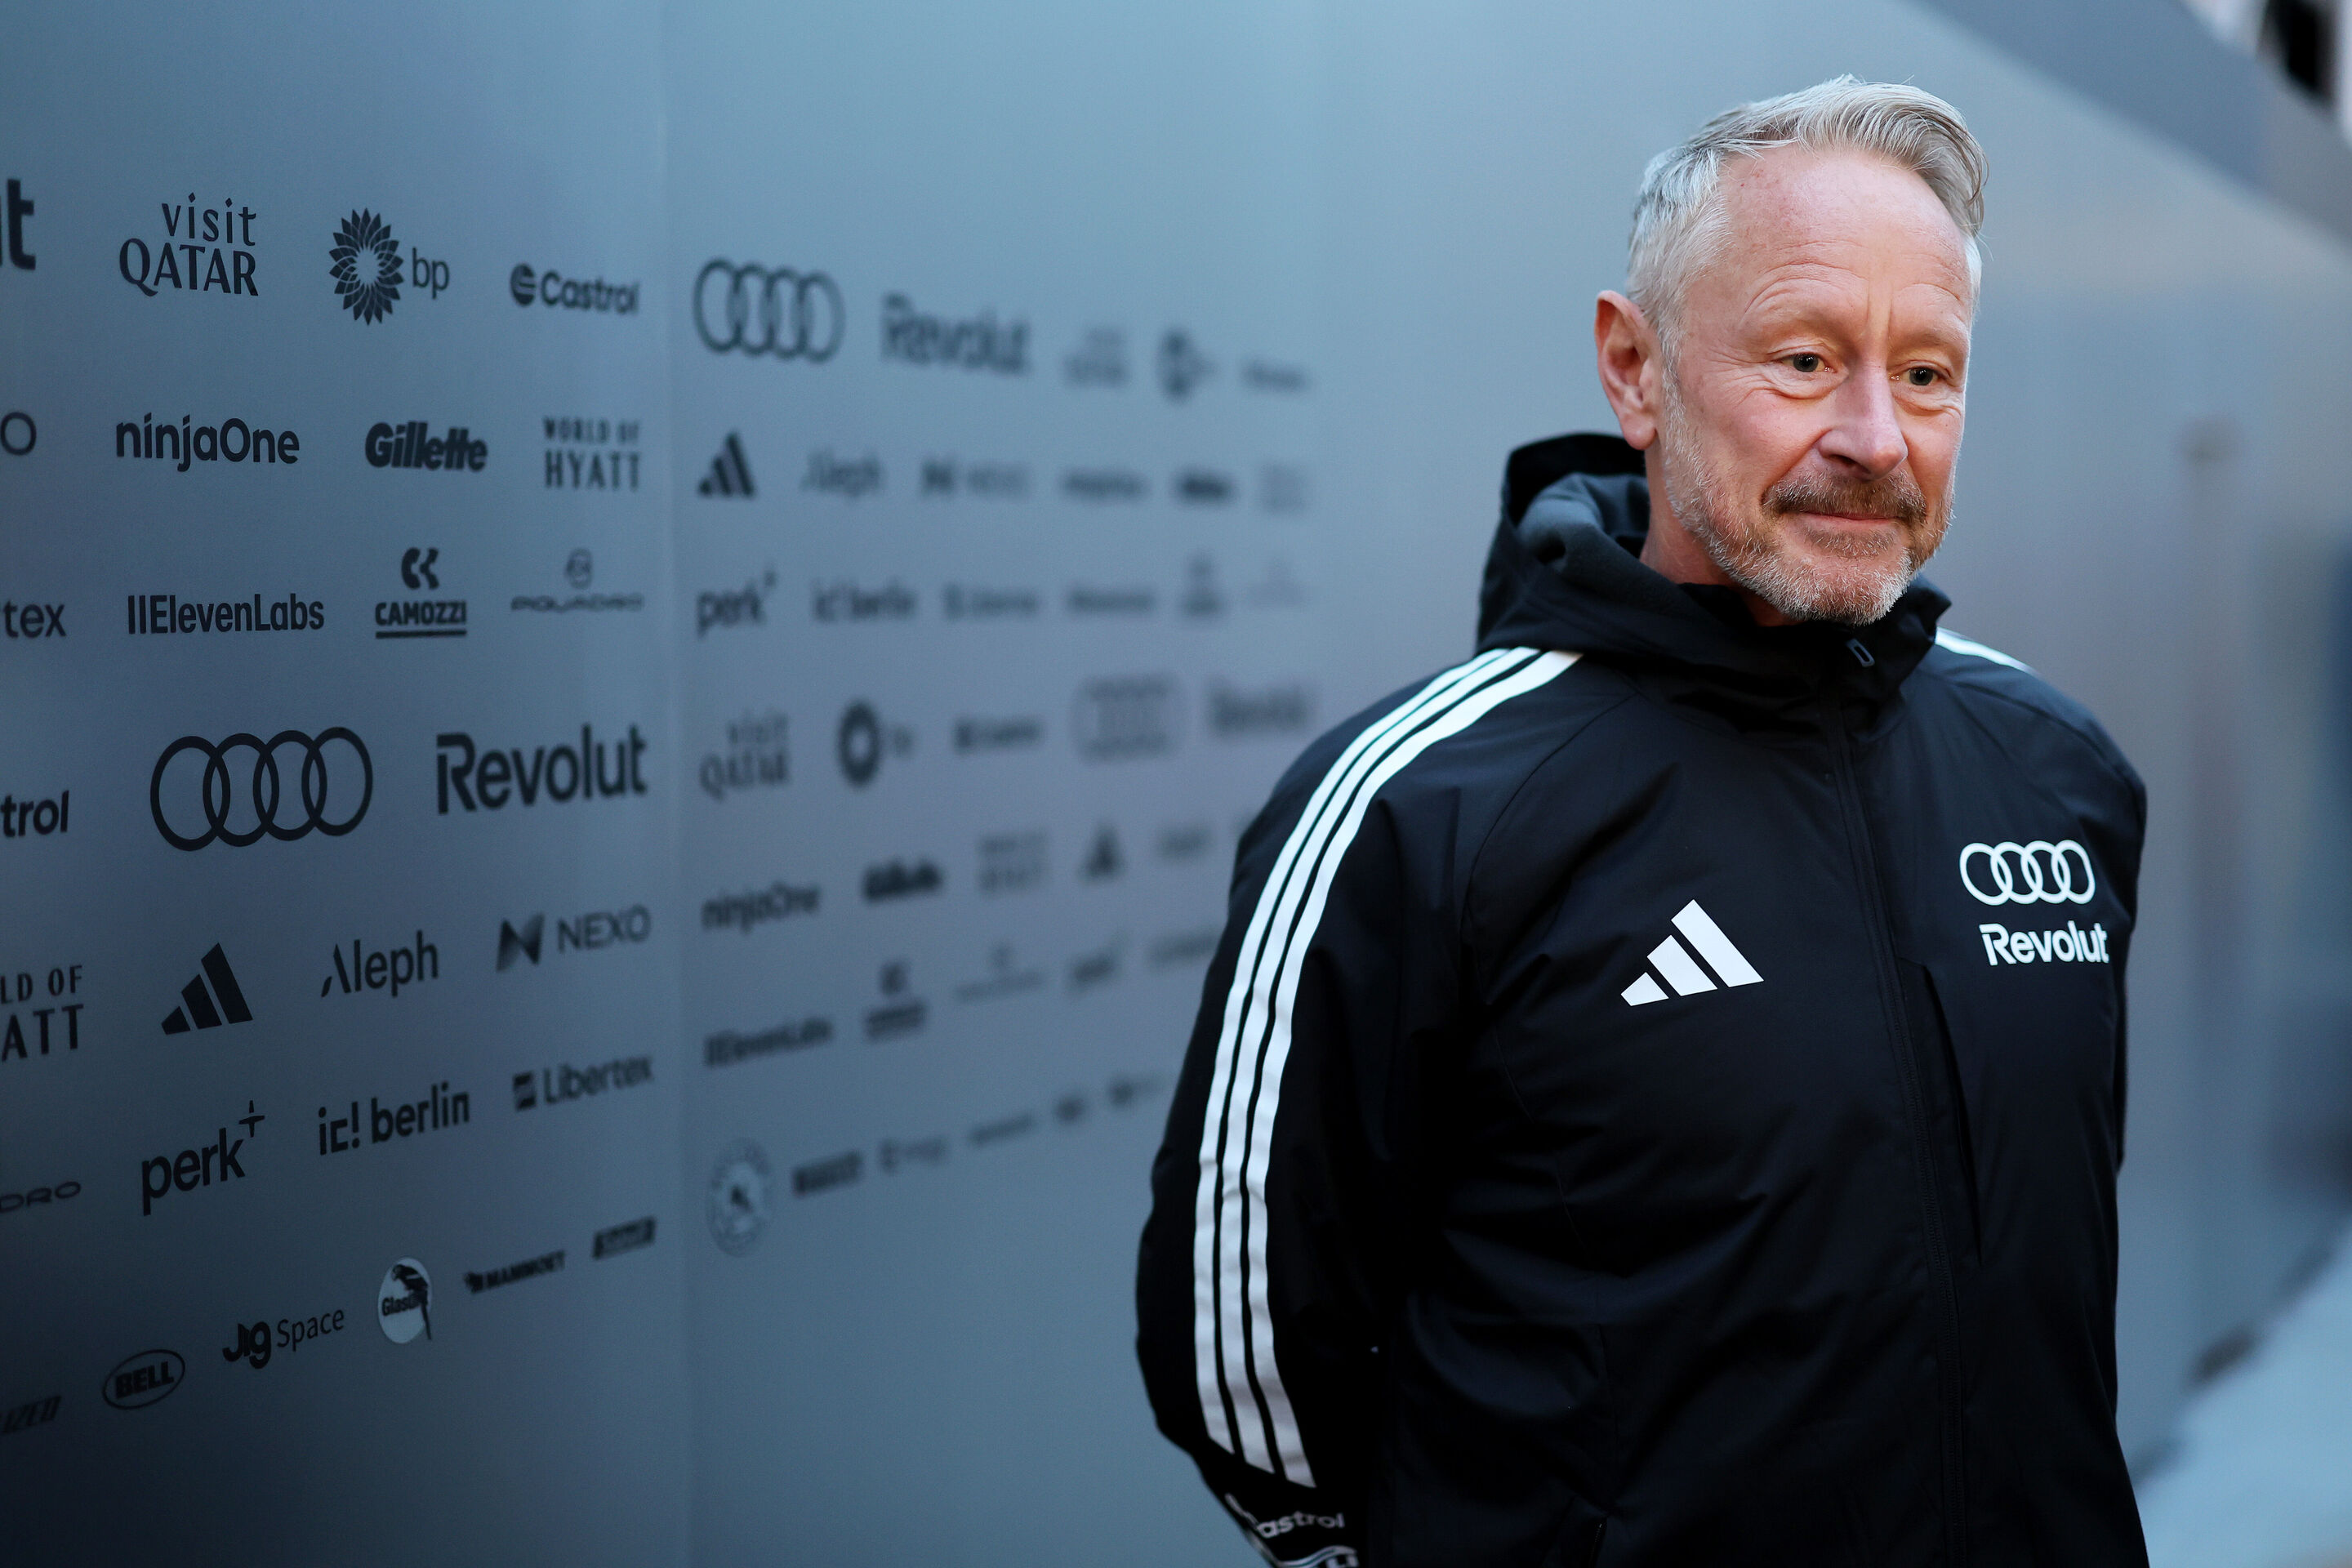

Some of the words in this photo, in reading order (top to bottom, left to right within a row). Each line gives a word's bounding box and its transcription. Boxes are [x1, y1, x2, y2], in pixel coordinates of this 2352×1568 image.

[162, 193, 256, 247] visit
[119, 237, 258, 296] QATAR
[412, 247, 450, 299] bp
[540, 270, 639, 314] Castrol
[116, 412, 300, 472] ninjaOne
[365, 421, 488, 471] Gillette
[544, 450, 639, 488] HYATT
[375, 600, 466, 626] CAMOZZI
[437, 725, 647, 814] Revolut
[557, 905, 651, 953] NEXO
[1979, 920, 2109, 966] Revolut
[48, 965, 82, 996] OF
[321, 930, 439, 997] Aleph
[371, 1081, 470, 1143] berlin
[114, 1361, 174, 1399] BELL
[1247, 1511, 1345, 1538] astrol
